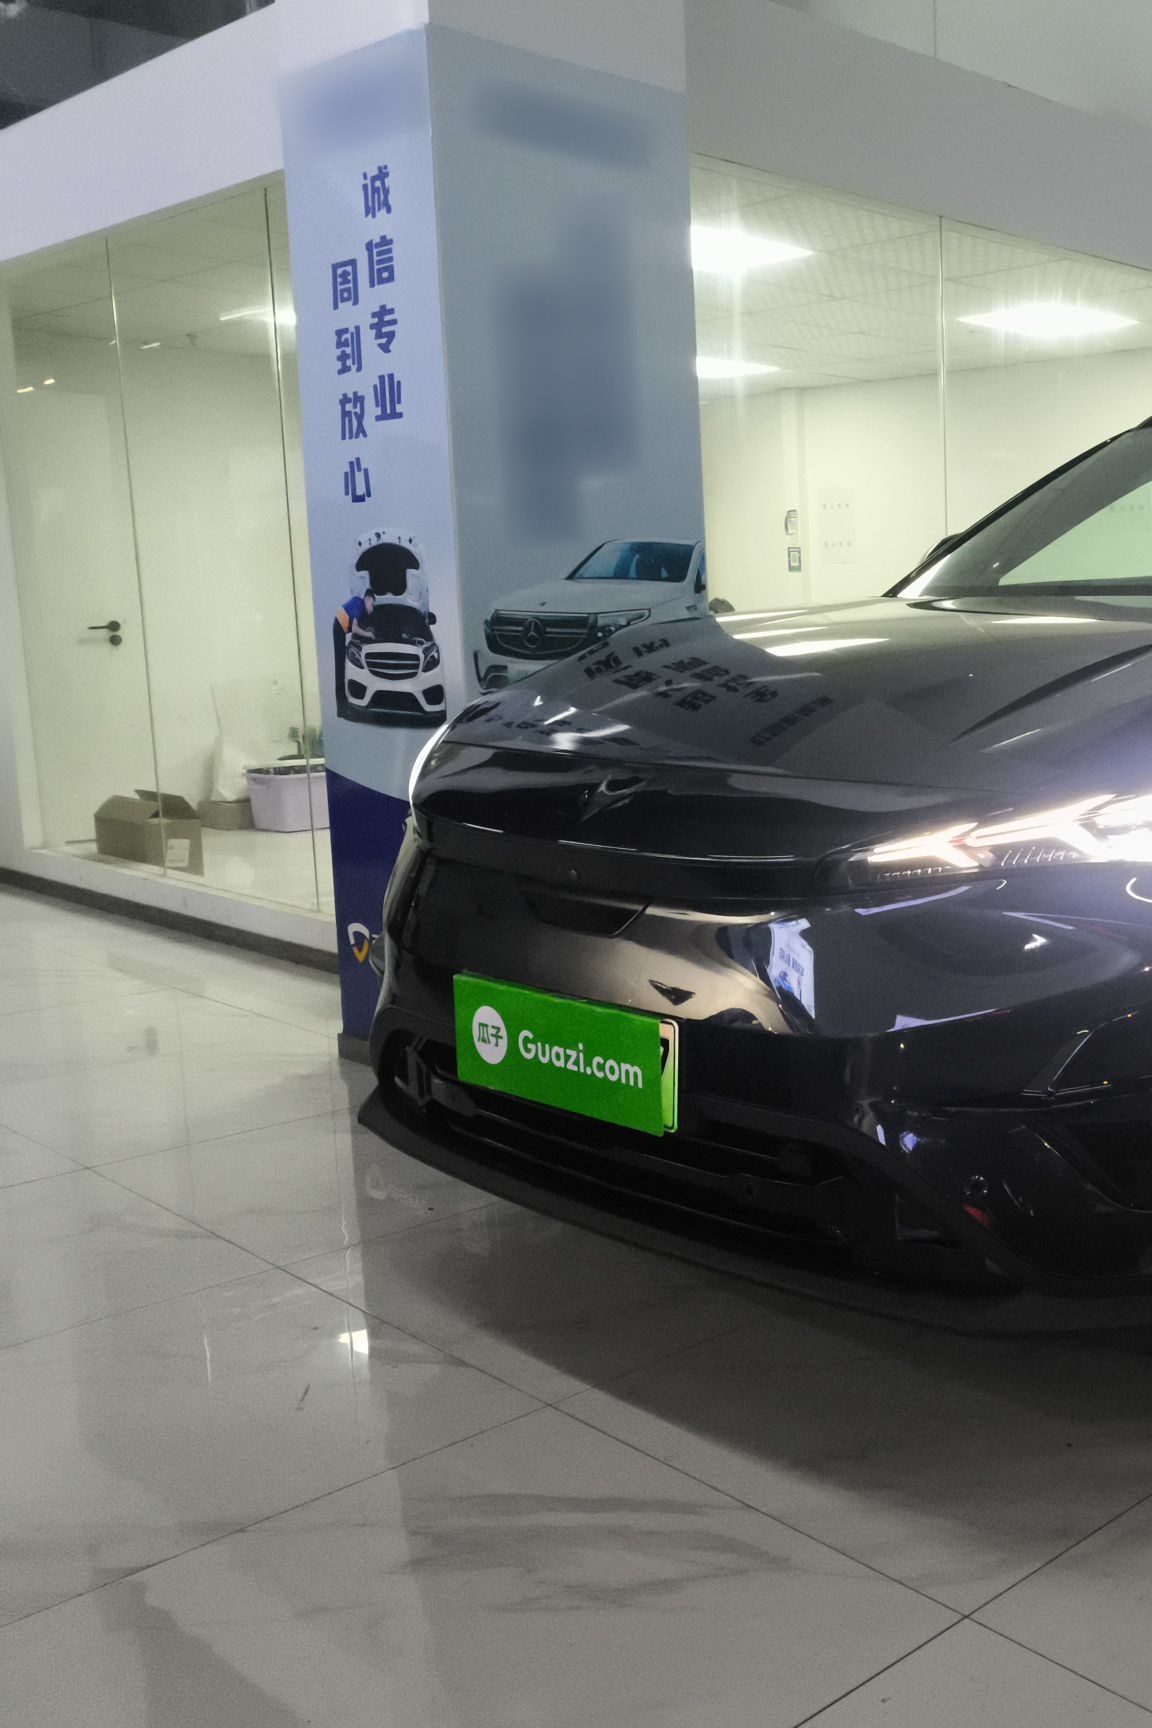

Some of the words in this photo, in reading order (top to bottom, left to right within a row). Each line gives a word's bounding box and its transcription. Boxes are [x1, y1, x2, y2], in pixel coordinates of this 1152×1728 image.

[332, 259, 372, 504] 周到放心
[362, 165, 403, 422] 诚信专业
[477, 1021, 504, 1048] 瓜子
[518, 1029, 643, 1089] Guazi.com
